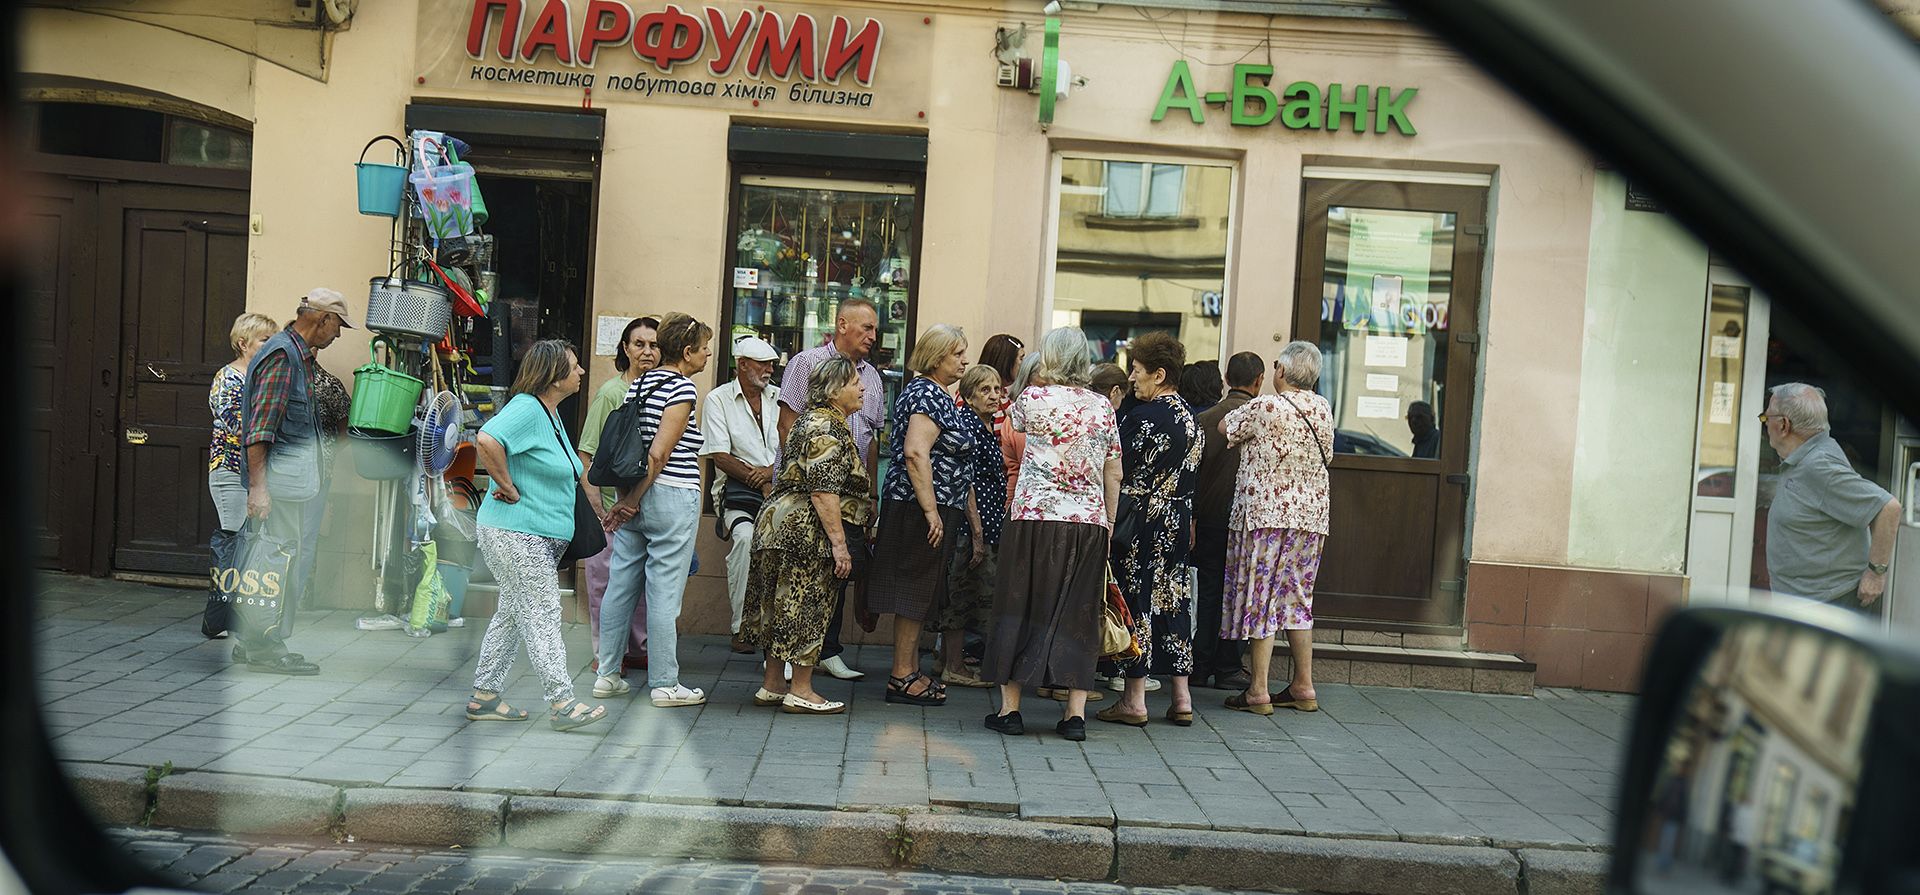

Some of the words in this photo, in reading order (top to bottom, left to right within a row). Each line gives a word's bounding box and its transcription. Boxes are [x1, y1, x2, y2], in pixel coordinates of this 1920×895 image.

[467, 0, 884, 87] ПАРФУМИ
[471, 65, 595, 88] косметика
[607, 72, 717, 96] побутова
[721, 80, 777, 100] хімія
[789, 82, 874, 107] білизна
[1151, 60, 1418, 136] А-Банк
